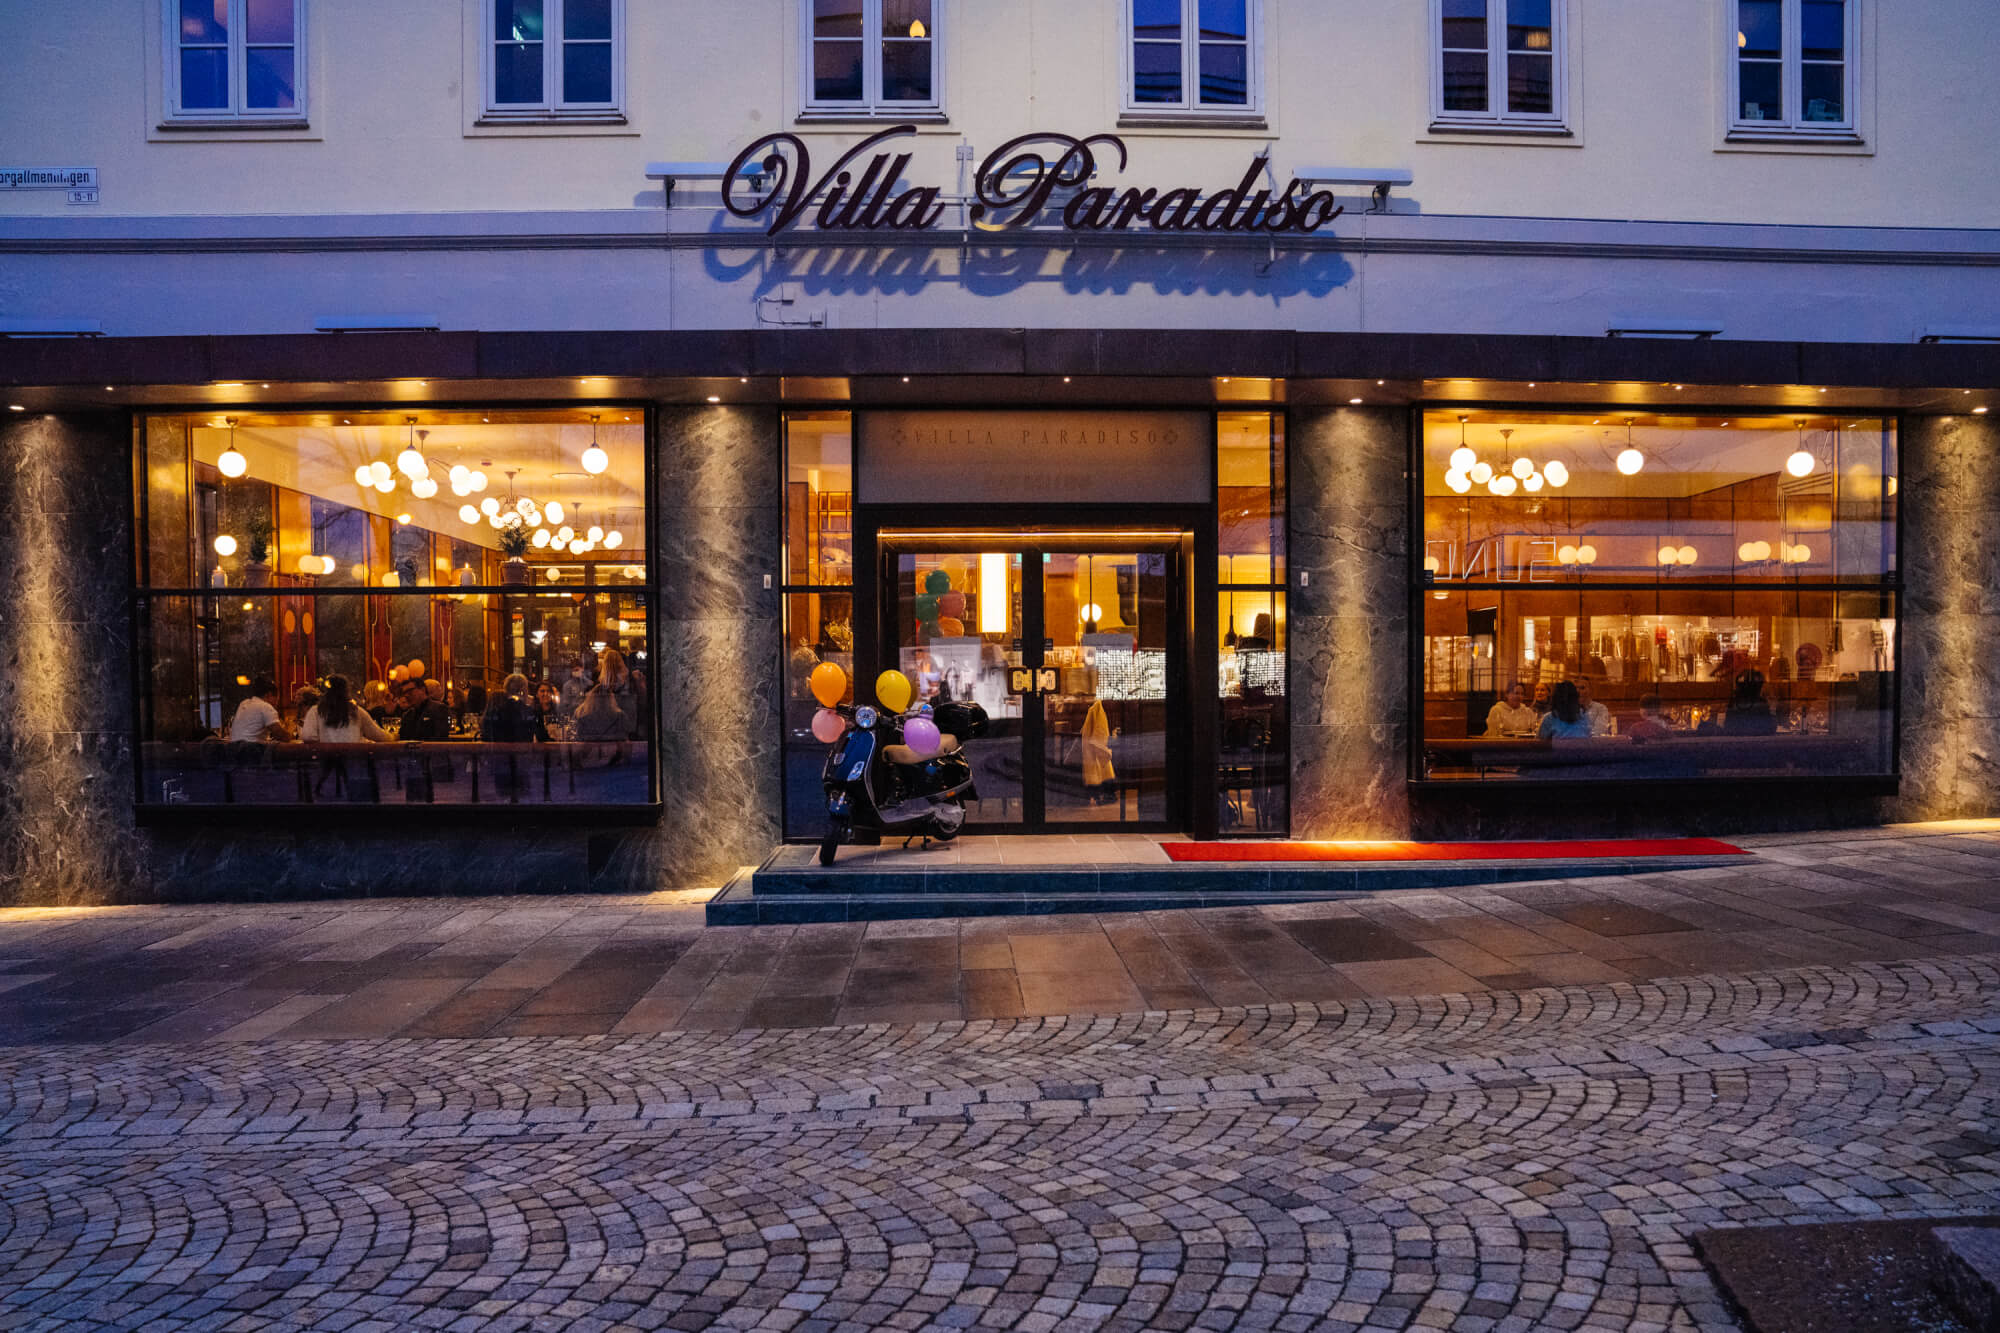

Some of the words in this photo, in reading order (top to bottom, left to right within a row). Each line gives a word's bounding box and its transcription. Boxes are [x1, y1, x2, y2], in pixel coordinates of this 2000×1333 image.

[721, 124, 945, 238] Villa
[968, 132, 1344, 233] Paradiso
[914, 429, 994, 445] VILLA
[1021, 429, 1157, 445] PARADISO
